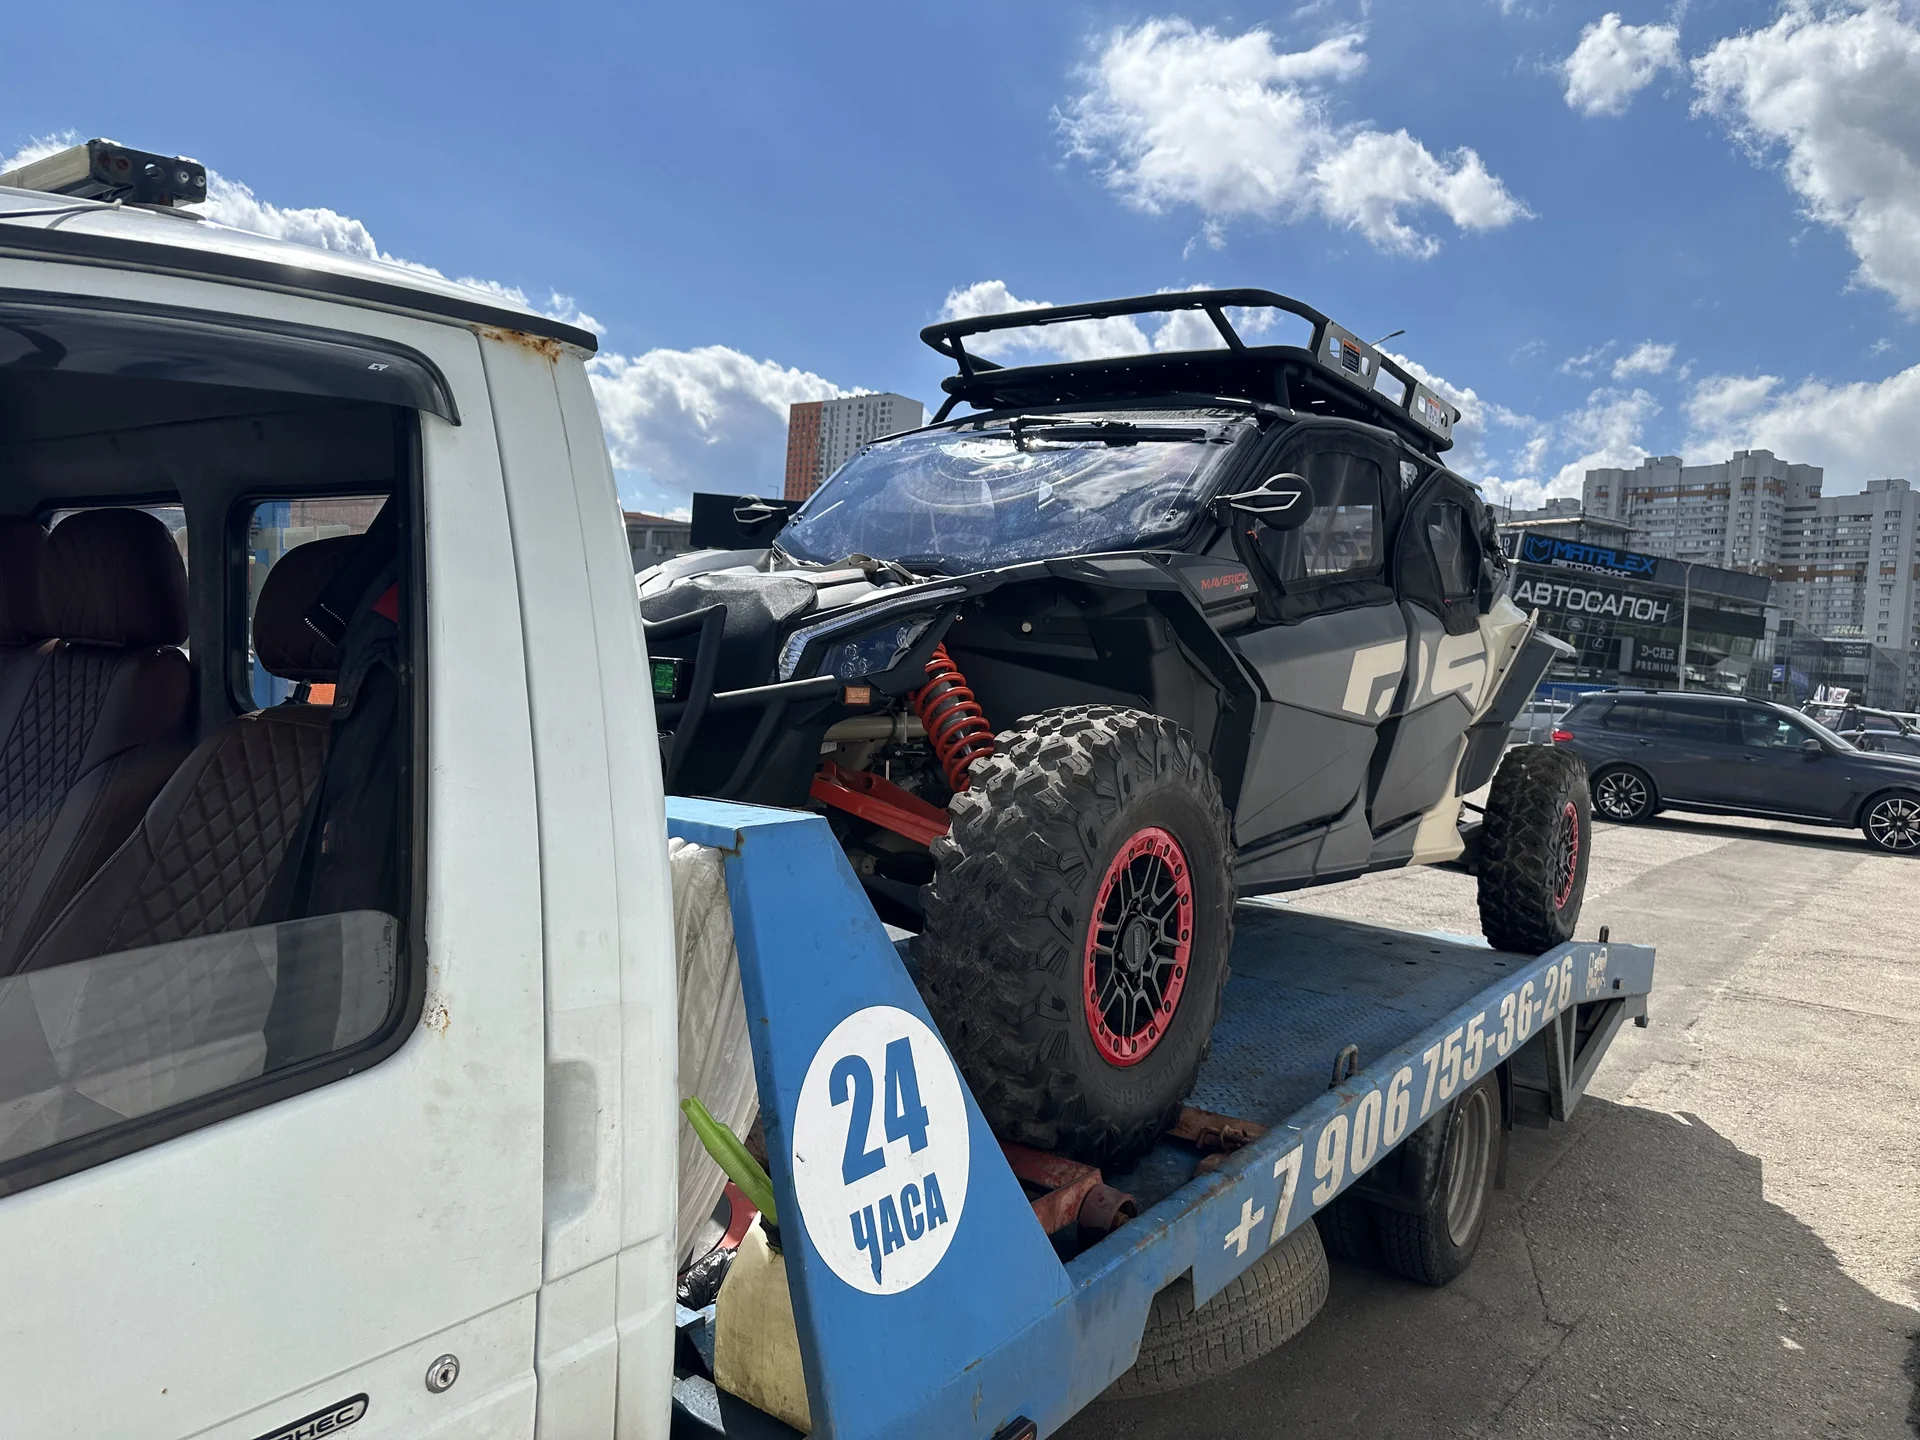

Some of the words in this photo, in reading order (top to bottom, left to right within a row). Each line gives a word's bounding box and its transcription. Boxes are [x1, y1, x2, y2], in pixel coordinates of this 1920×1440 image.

[1552, 542, 1656, 574] MATALEX
[1201, 571, 1249, 590] MAVERICK
[1514, 580, 1669, 622] АВТОСАЛОН
[1831, 625, 1868, 635] SKILL
[1635, 660, 1678, 674] PREMIUM
[1641, 645, 1675, 660] D-CAR
[1312, 1065, 1413, 1207] 906
[1418, 955, 1574, 1120] 755-36-26
[829, 1036, 930, 1186] 24
[849, 1171, 948, 1285] ЧАСА
